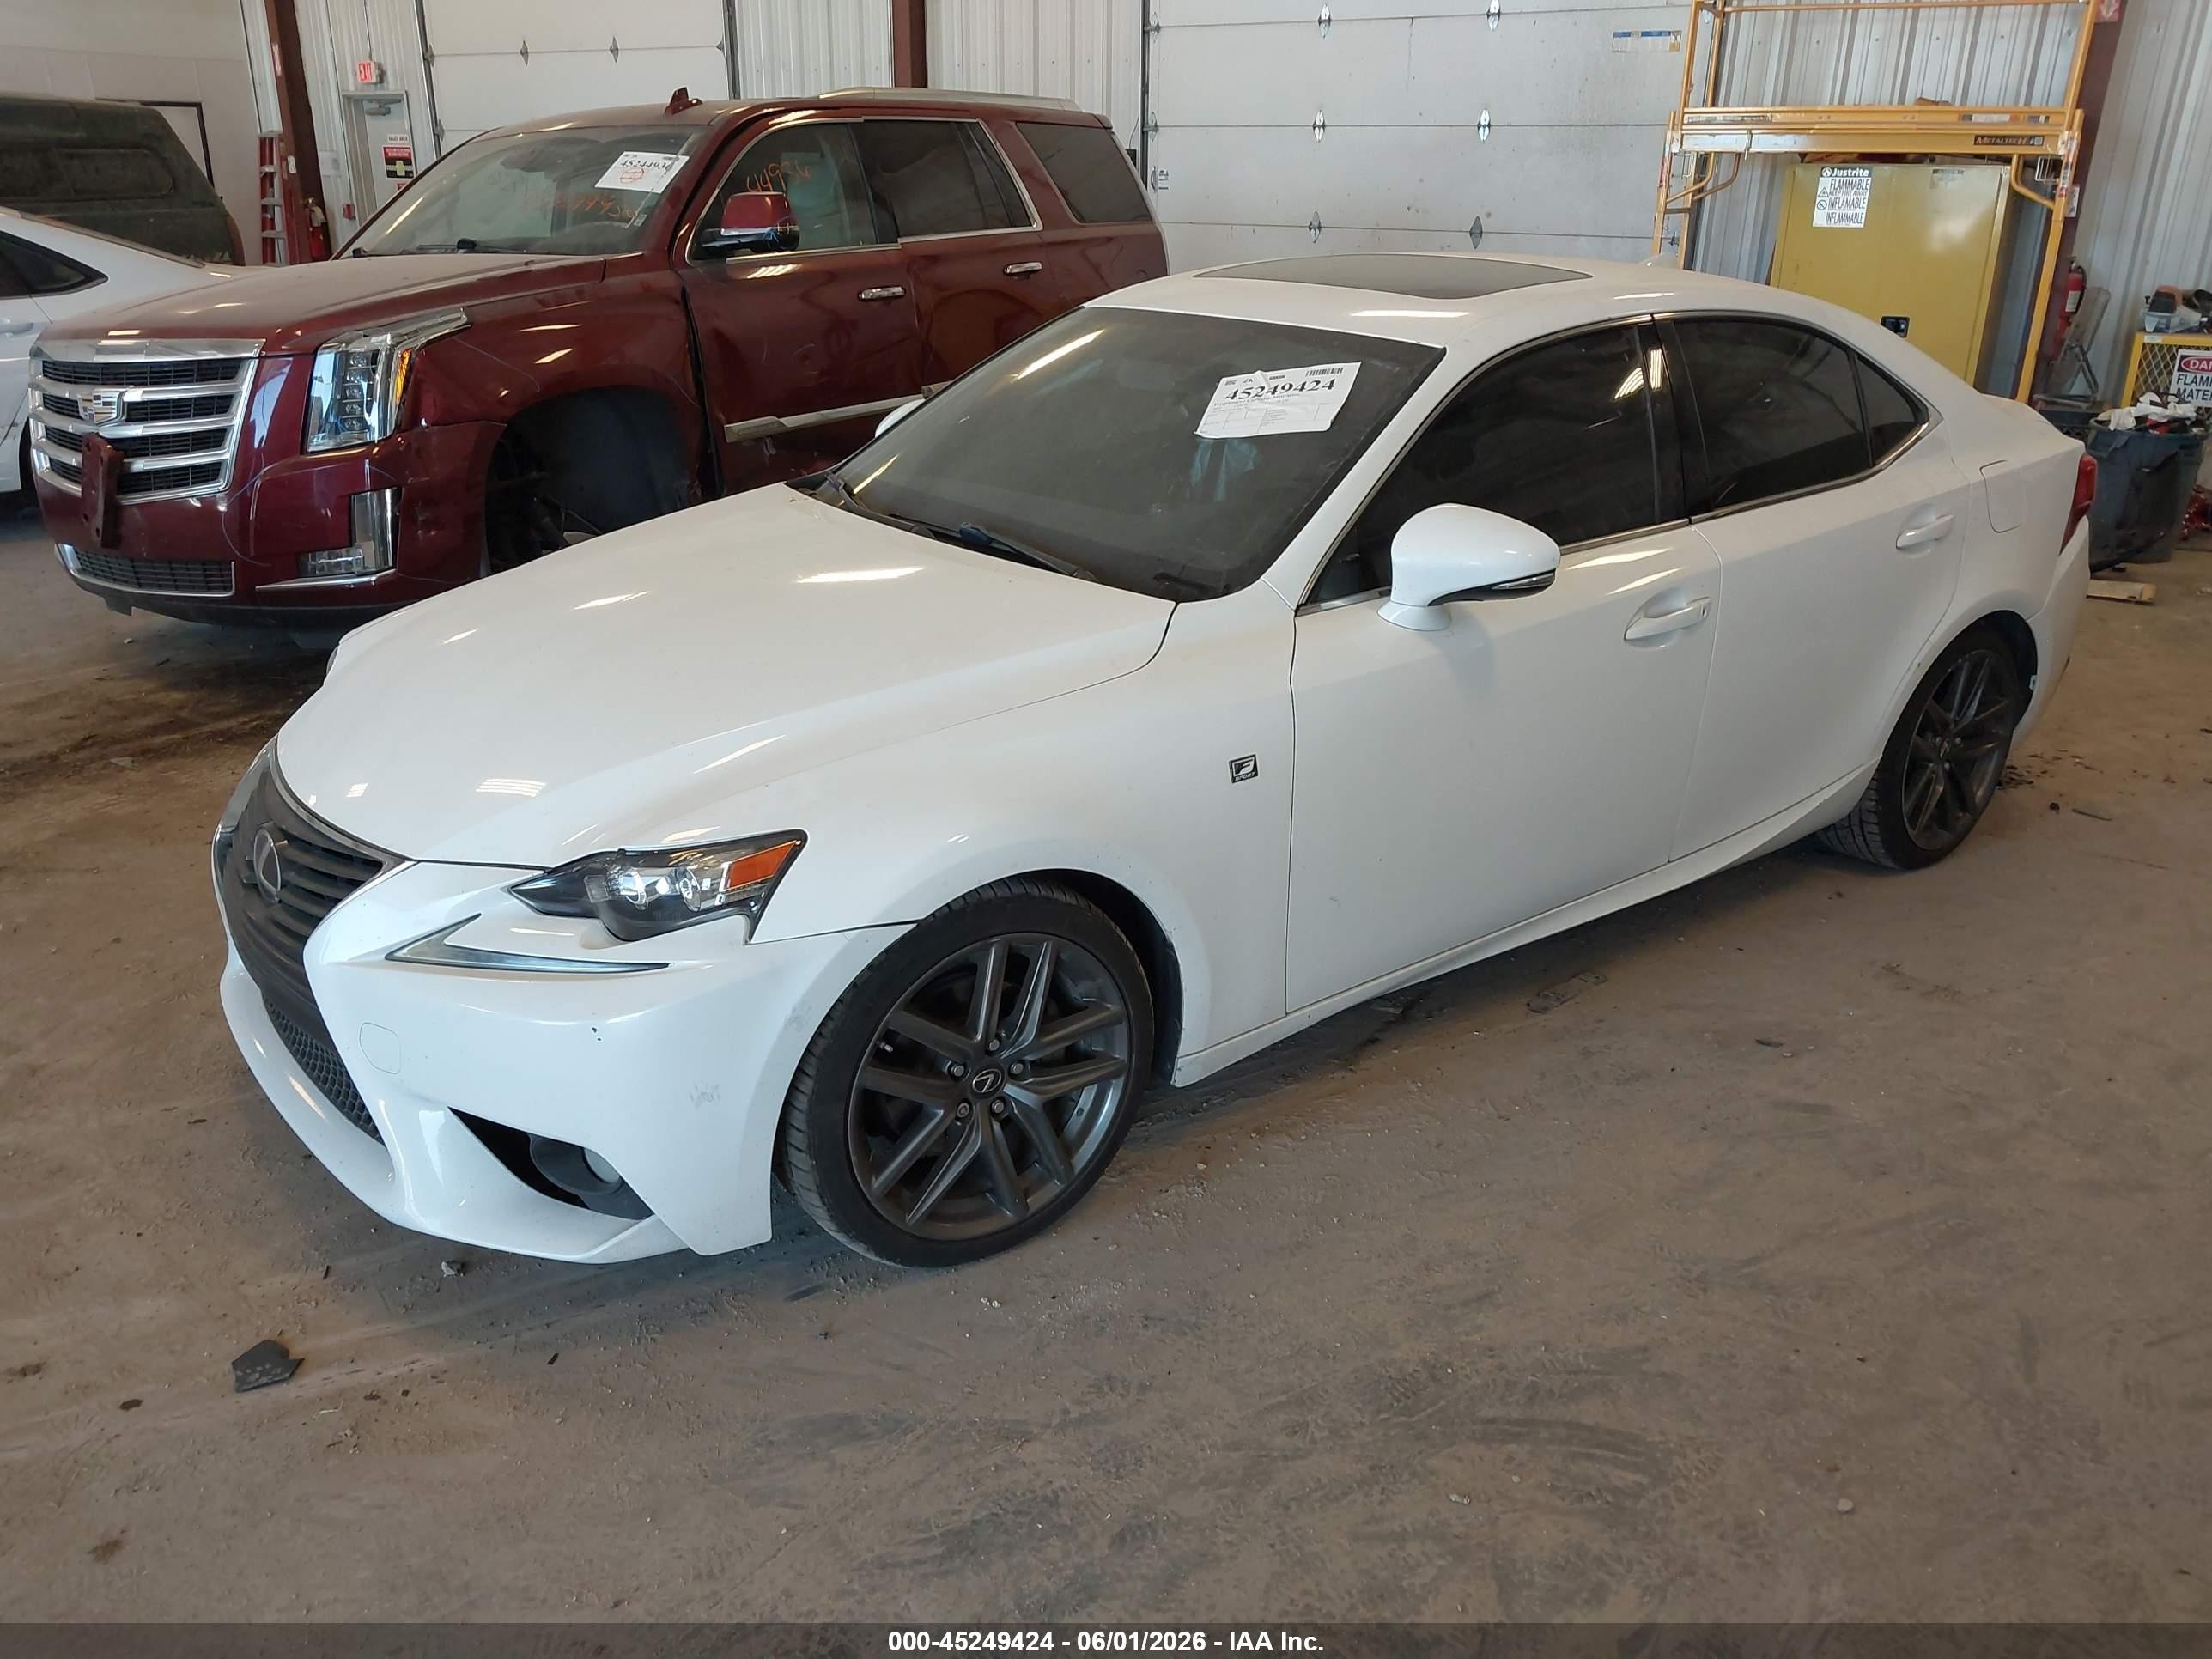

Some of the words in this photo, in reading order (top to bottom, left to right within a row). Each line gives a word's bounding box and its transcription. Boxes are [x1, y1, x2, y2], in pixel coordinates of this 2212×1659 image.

[1832, 167, 1869, 177] Justrite
[1830, 179, 1869, 190] FLAMMABLE
[1828, 198, 1866, 209] INFLAMABLE
[1826, 211, 1864, 224] INFLAMMABLE
[1225, 378, 1336, 401] 45249424
